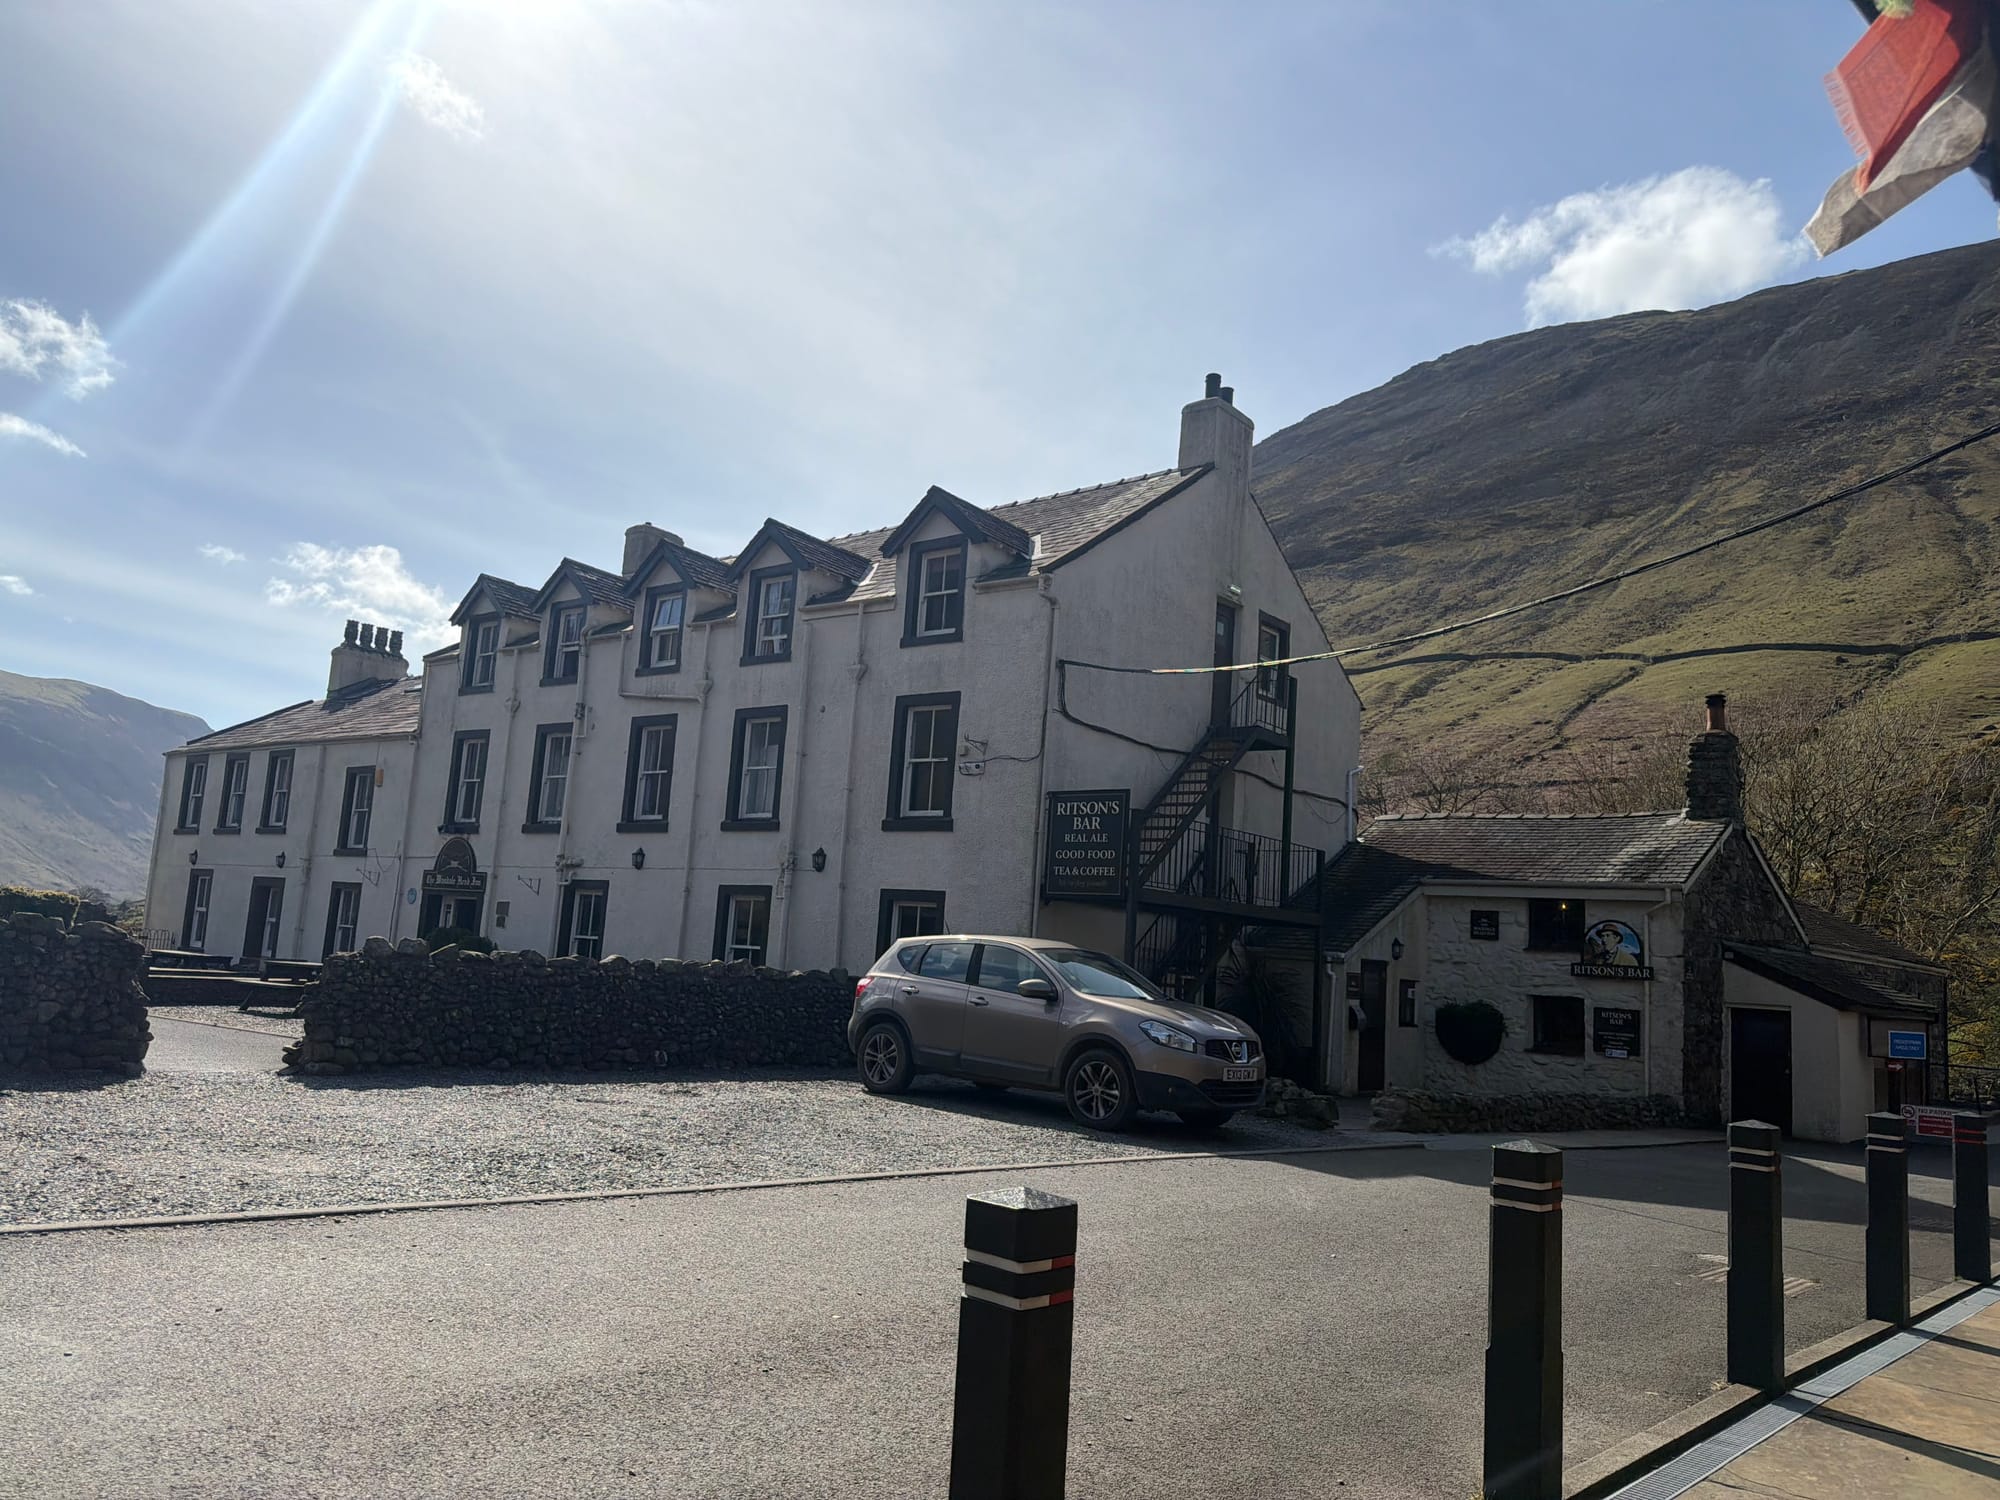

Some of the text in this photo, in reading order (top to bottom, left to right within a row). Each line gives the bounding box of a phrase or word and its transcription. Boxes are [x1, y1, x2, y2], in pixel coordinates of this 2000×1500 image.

[1057, 801, 1120, 816] RITSON'S
[1073, 817, 1101, 830] BAR
[1064, 833, 1109, 843] REAL ALE
[1055, 849, 1116, 859] GOOD FOOD
[1574, 965, 1651, 979] RITSON'S BAR
